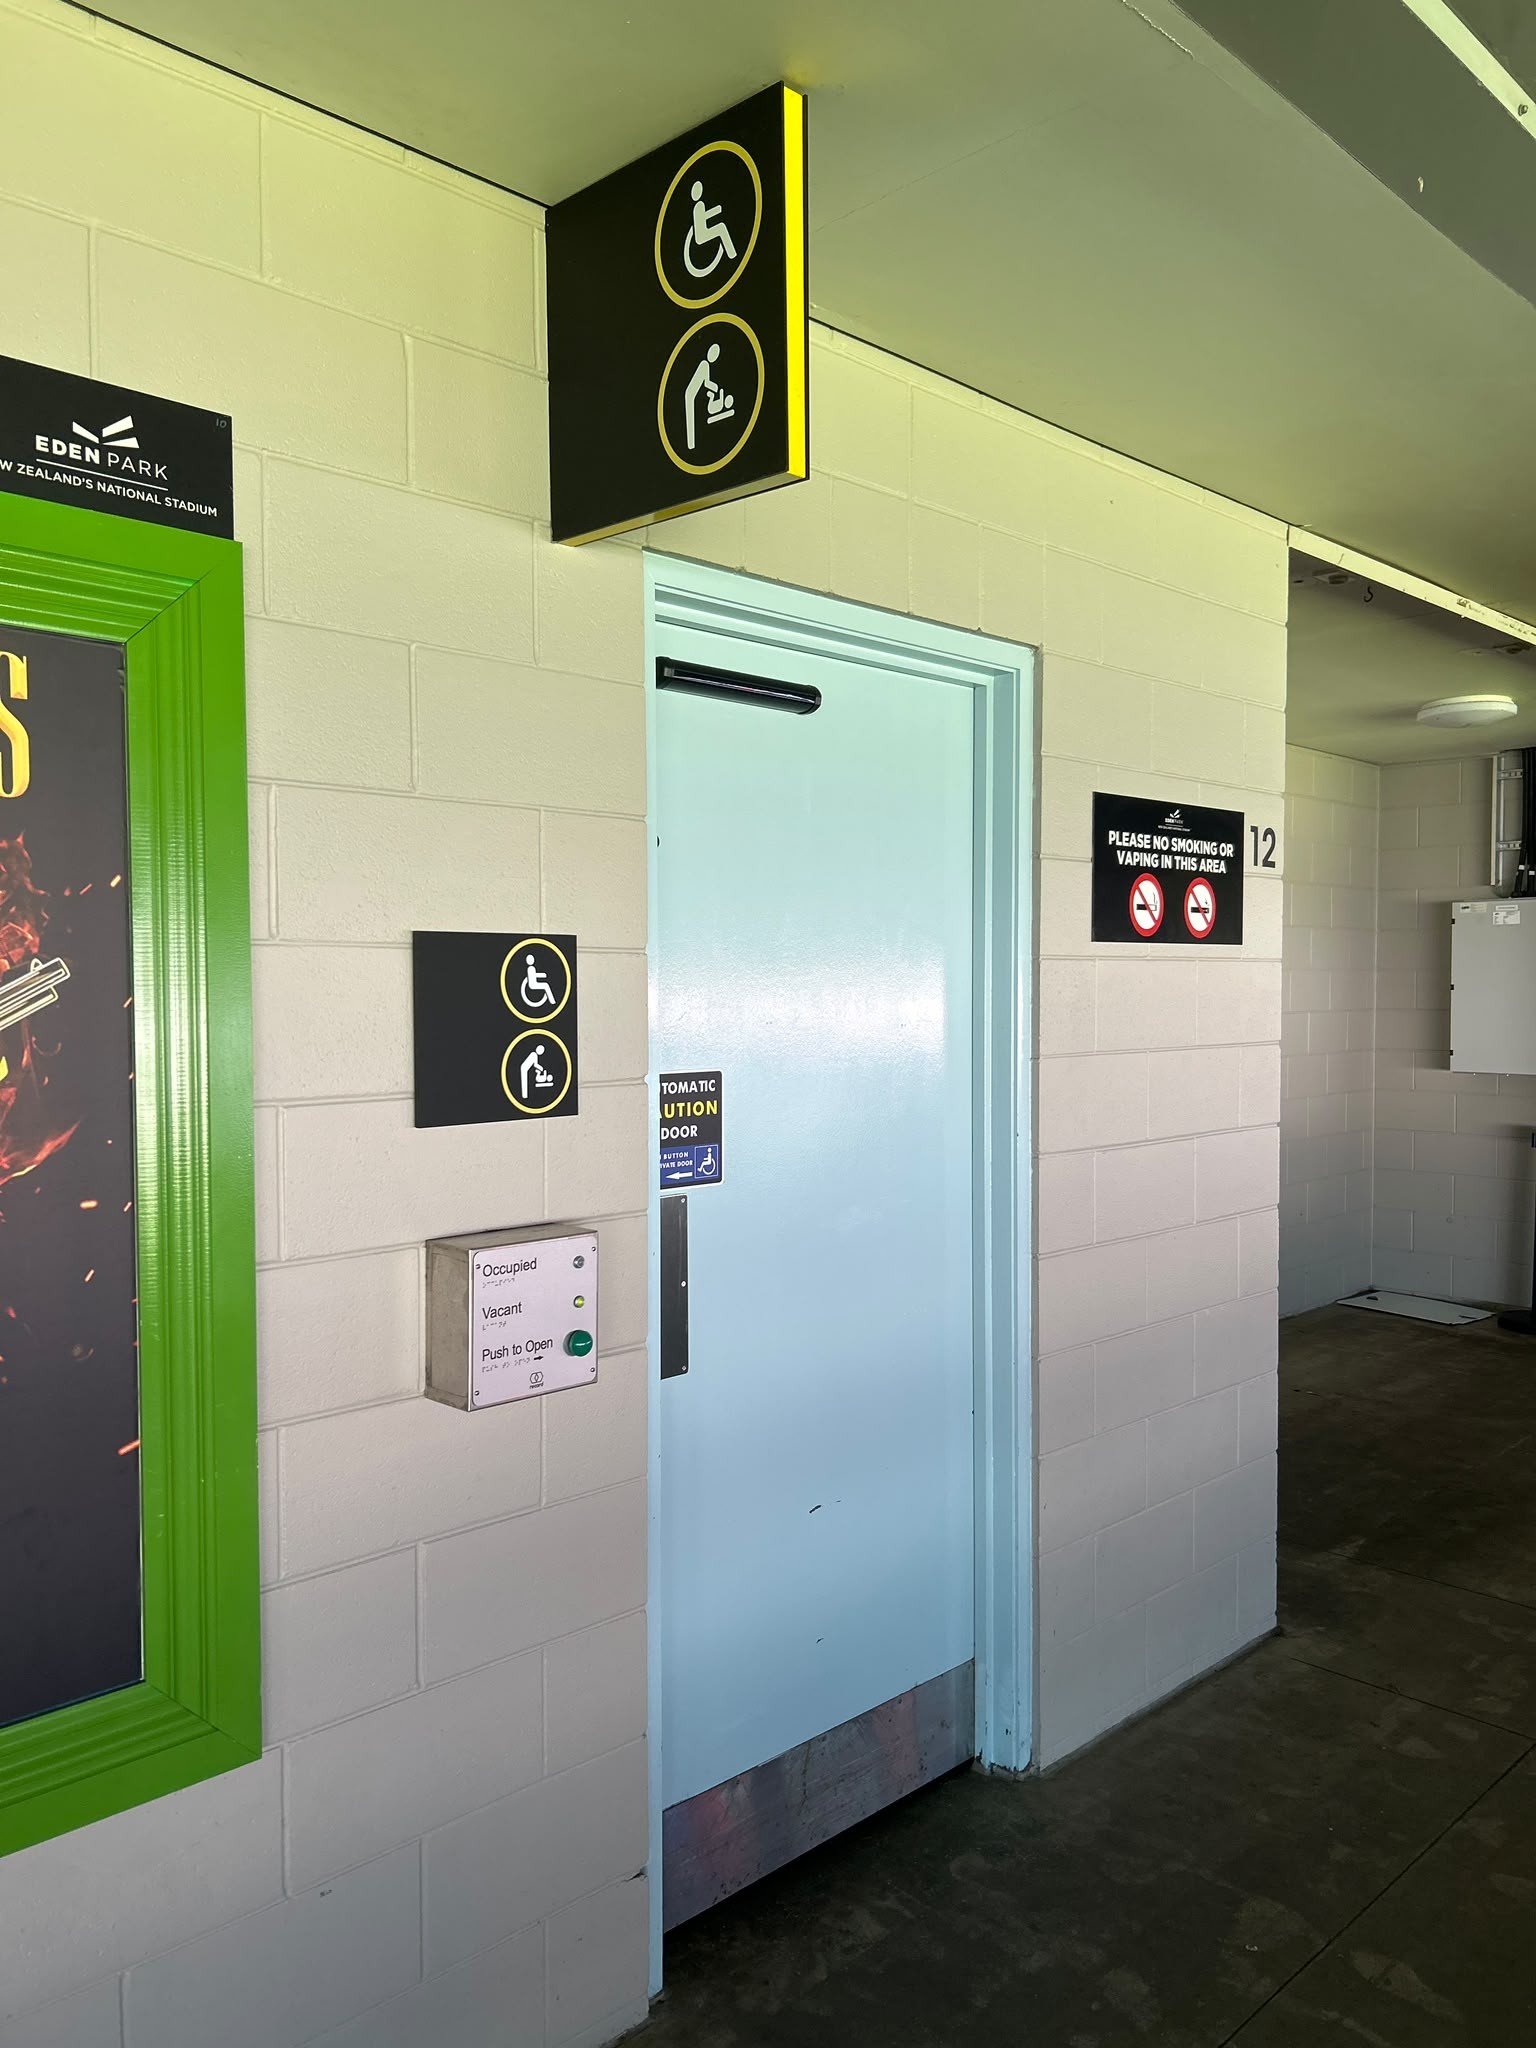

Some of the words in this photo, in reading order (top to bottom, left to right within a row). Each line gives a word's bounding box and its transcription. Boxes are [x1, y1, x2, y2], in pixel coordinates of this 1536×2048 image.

[35, 434, 100, 464] EDEN
[107, 452, 168, 481] PARK
[17, 463, 94, 489] ZEALAND'S
[97, 481, 161, 506] NATIONAL
[164, 497, 218, 517] STADIUM
[1108, 830, 1151, 849] PLEASE
[1153, 836, 1169, 850] NO
[1171, 837, 1218, 856] SMOKING
[1219, 842, 1234, 857] OR
[1250, 825, 1276, 868] 12
[1117, 850, 1159, 868] VAPING
[1160, 855, 1173, 869] IN
[1174, 856, 1197, 872] THIS
[1199, 859, 1227, 874] AREA
[659, 1100, 718, 1119] UTION
[661, 1125, 698, 1140] DOOR
[663, 1151, 689, 1160] BUTTON
[677, 1160, 694, 1168] DOOR
[482, 1257, 537, 1277] Occupied
[482, 1302, 522, 1320] Vacant
[482, 1347, 509, 1362] Push
[512, 1344, 522, 1356] to
[525, 1338, 553, 1355] Open
